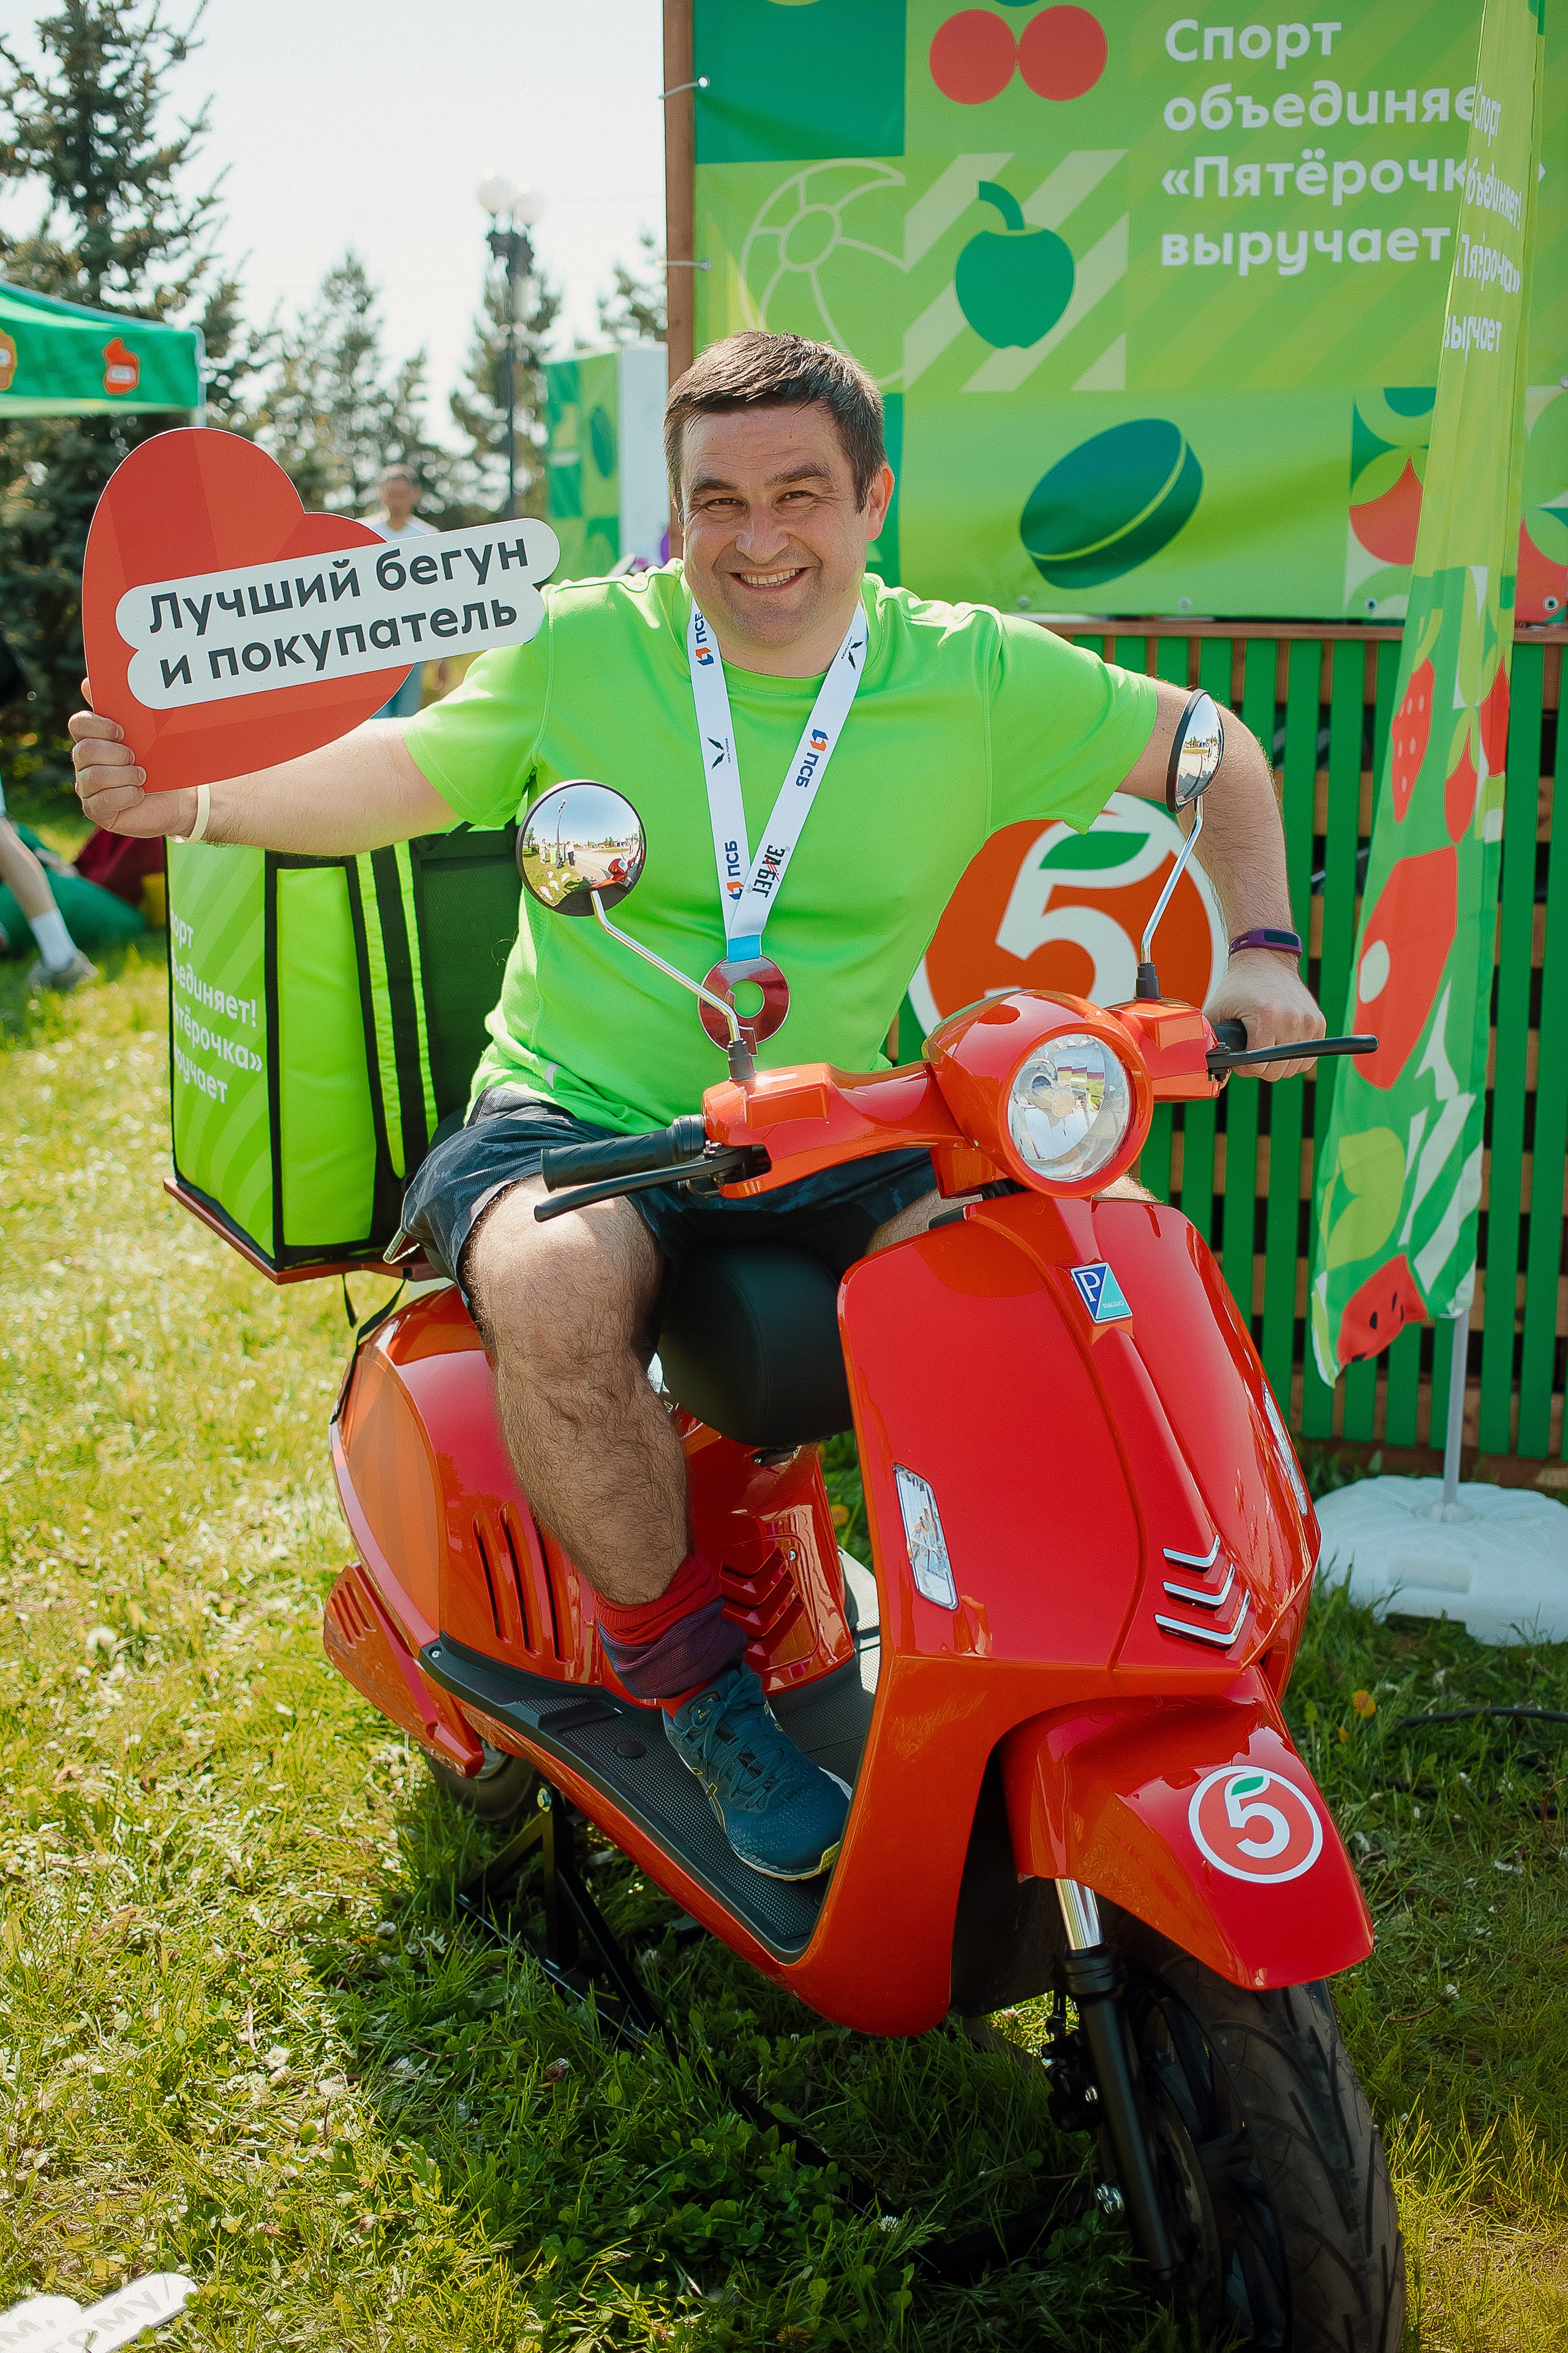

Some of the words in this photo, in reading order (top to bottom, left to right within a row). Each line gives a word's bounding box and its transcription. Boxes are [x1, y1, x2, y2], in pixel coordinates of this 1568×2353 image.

[1165, 19, 1342, 69] Спорт
[1162, 148, 1547, 206] «Пятёрочк
[1161, 227, 1451, 277] выручает
[149, 559, 361, 636] Лучший
[376, 538, 529, 592] бегун
[159, 653, 192, 690] и
[208, 599, 518, 671] покупатель
[695, 612, 707, 644] ПСБ
[796, 752, 820, 788] ПСБ
[725, 840, 741, 877] ПСБ
[171, 909, 194, 950] орт
[172, 991, 263, 1073] тёрочка»
[174, 1043, 228, 1104] ручает
[1077, 1271, 1101, 1302] P
[1102, 1300, 1125, 1309] PIAGGIO
[1224, 1772, 1290, 1859] 5
